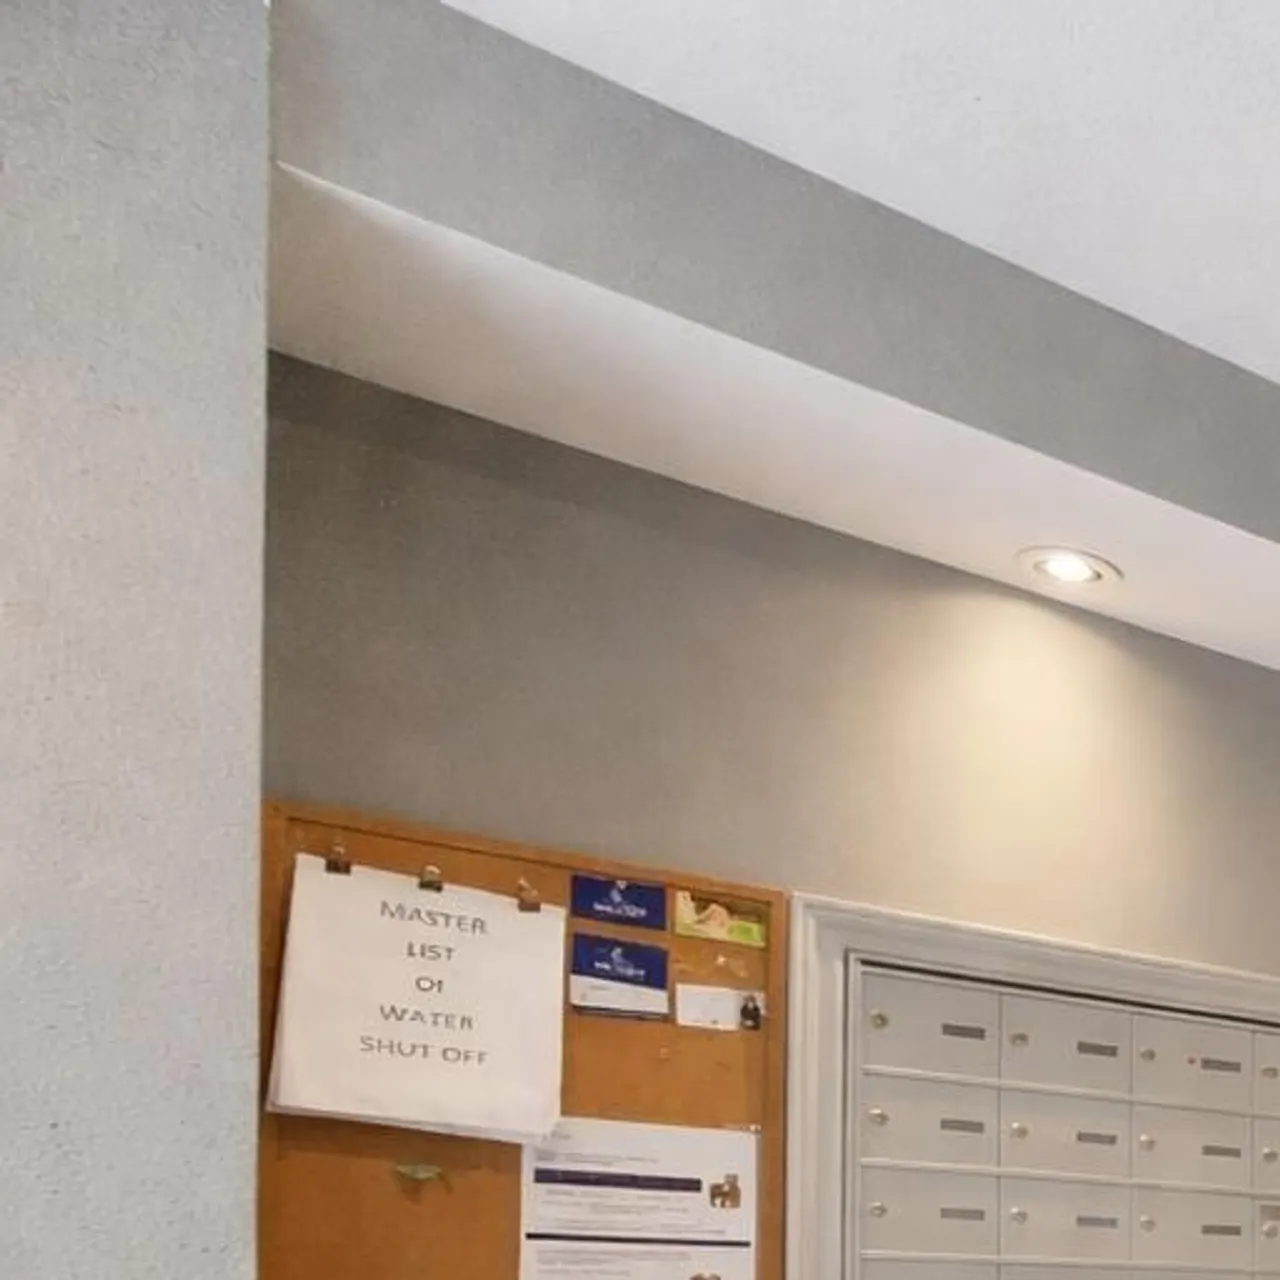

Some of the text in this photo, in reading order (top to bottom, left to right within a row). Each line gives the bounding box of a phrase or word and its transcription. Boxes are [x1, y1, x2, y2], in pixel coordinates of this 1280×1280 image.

[380, 900, 488, 934] MASTER
[407, 941, 456, 961] LIST
[380, 1004, 475, 1030] WATER
[360, 1035, 488, 1065] SHUT OFF
